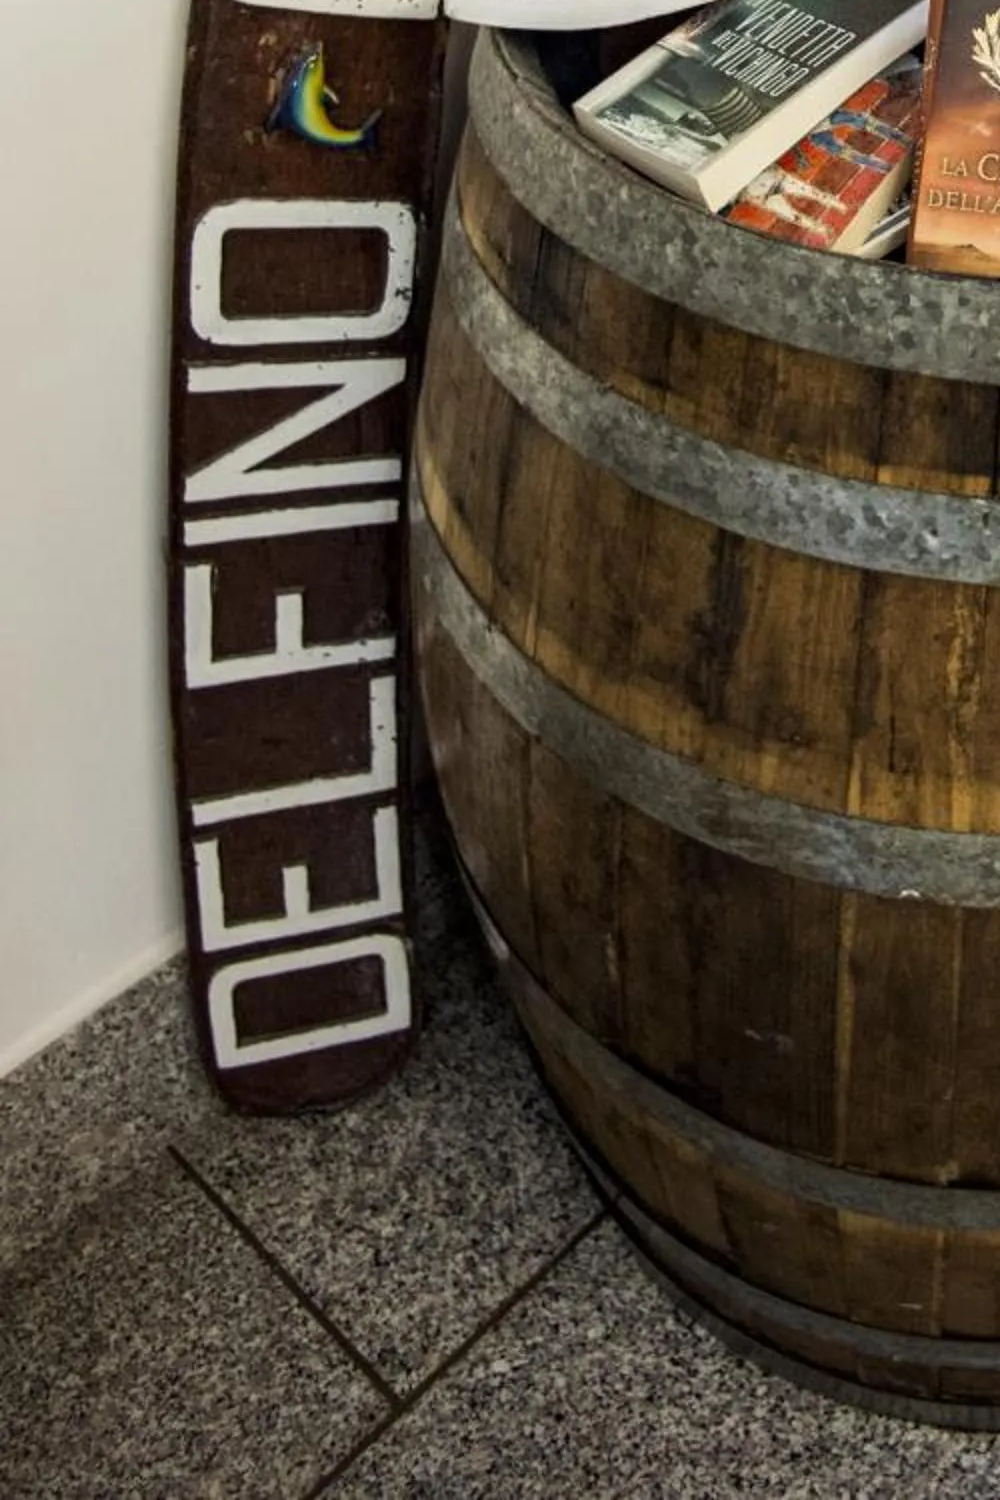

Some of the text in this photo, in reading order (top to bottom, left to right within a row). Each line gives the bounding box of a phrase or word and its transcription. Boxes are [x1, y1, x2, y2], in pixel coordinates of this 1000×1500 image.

[712, 38, 810, 97] VICHINGO
[942, 157, 968, 177] LA
[184, 198, 416, 1069] DELFINO
